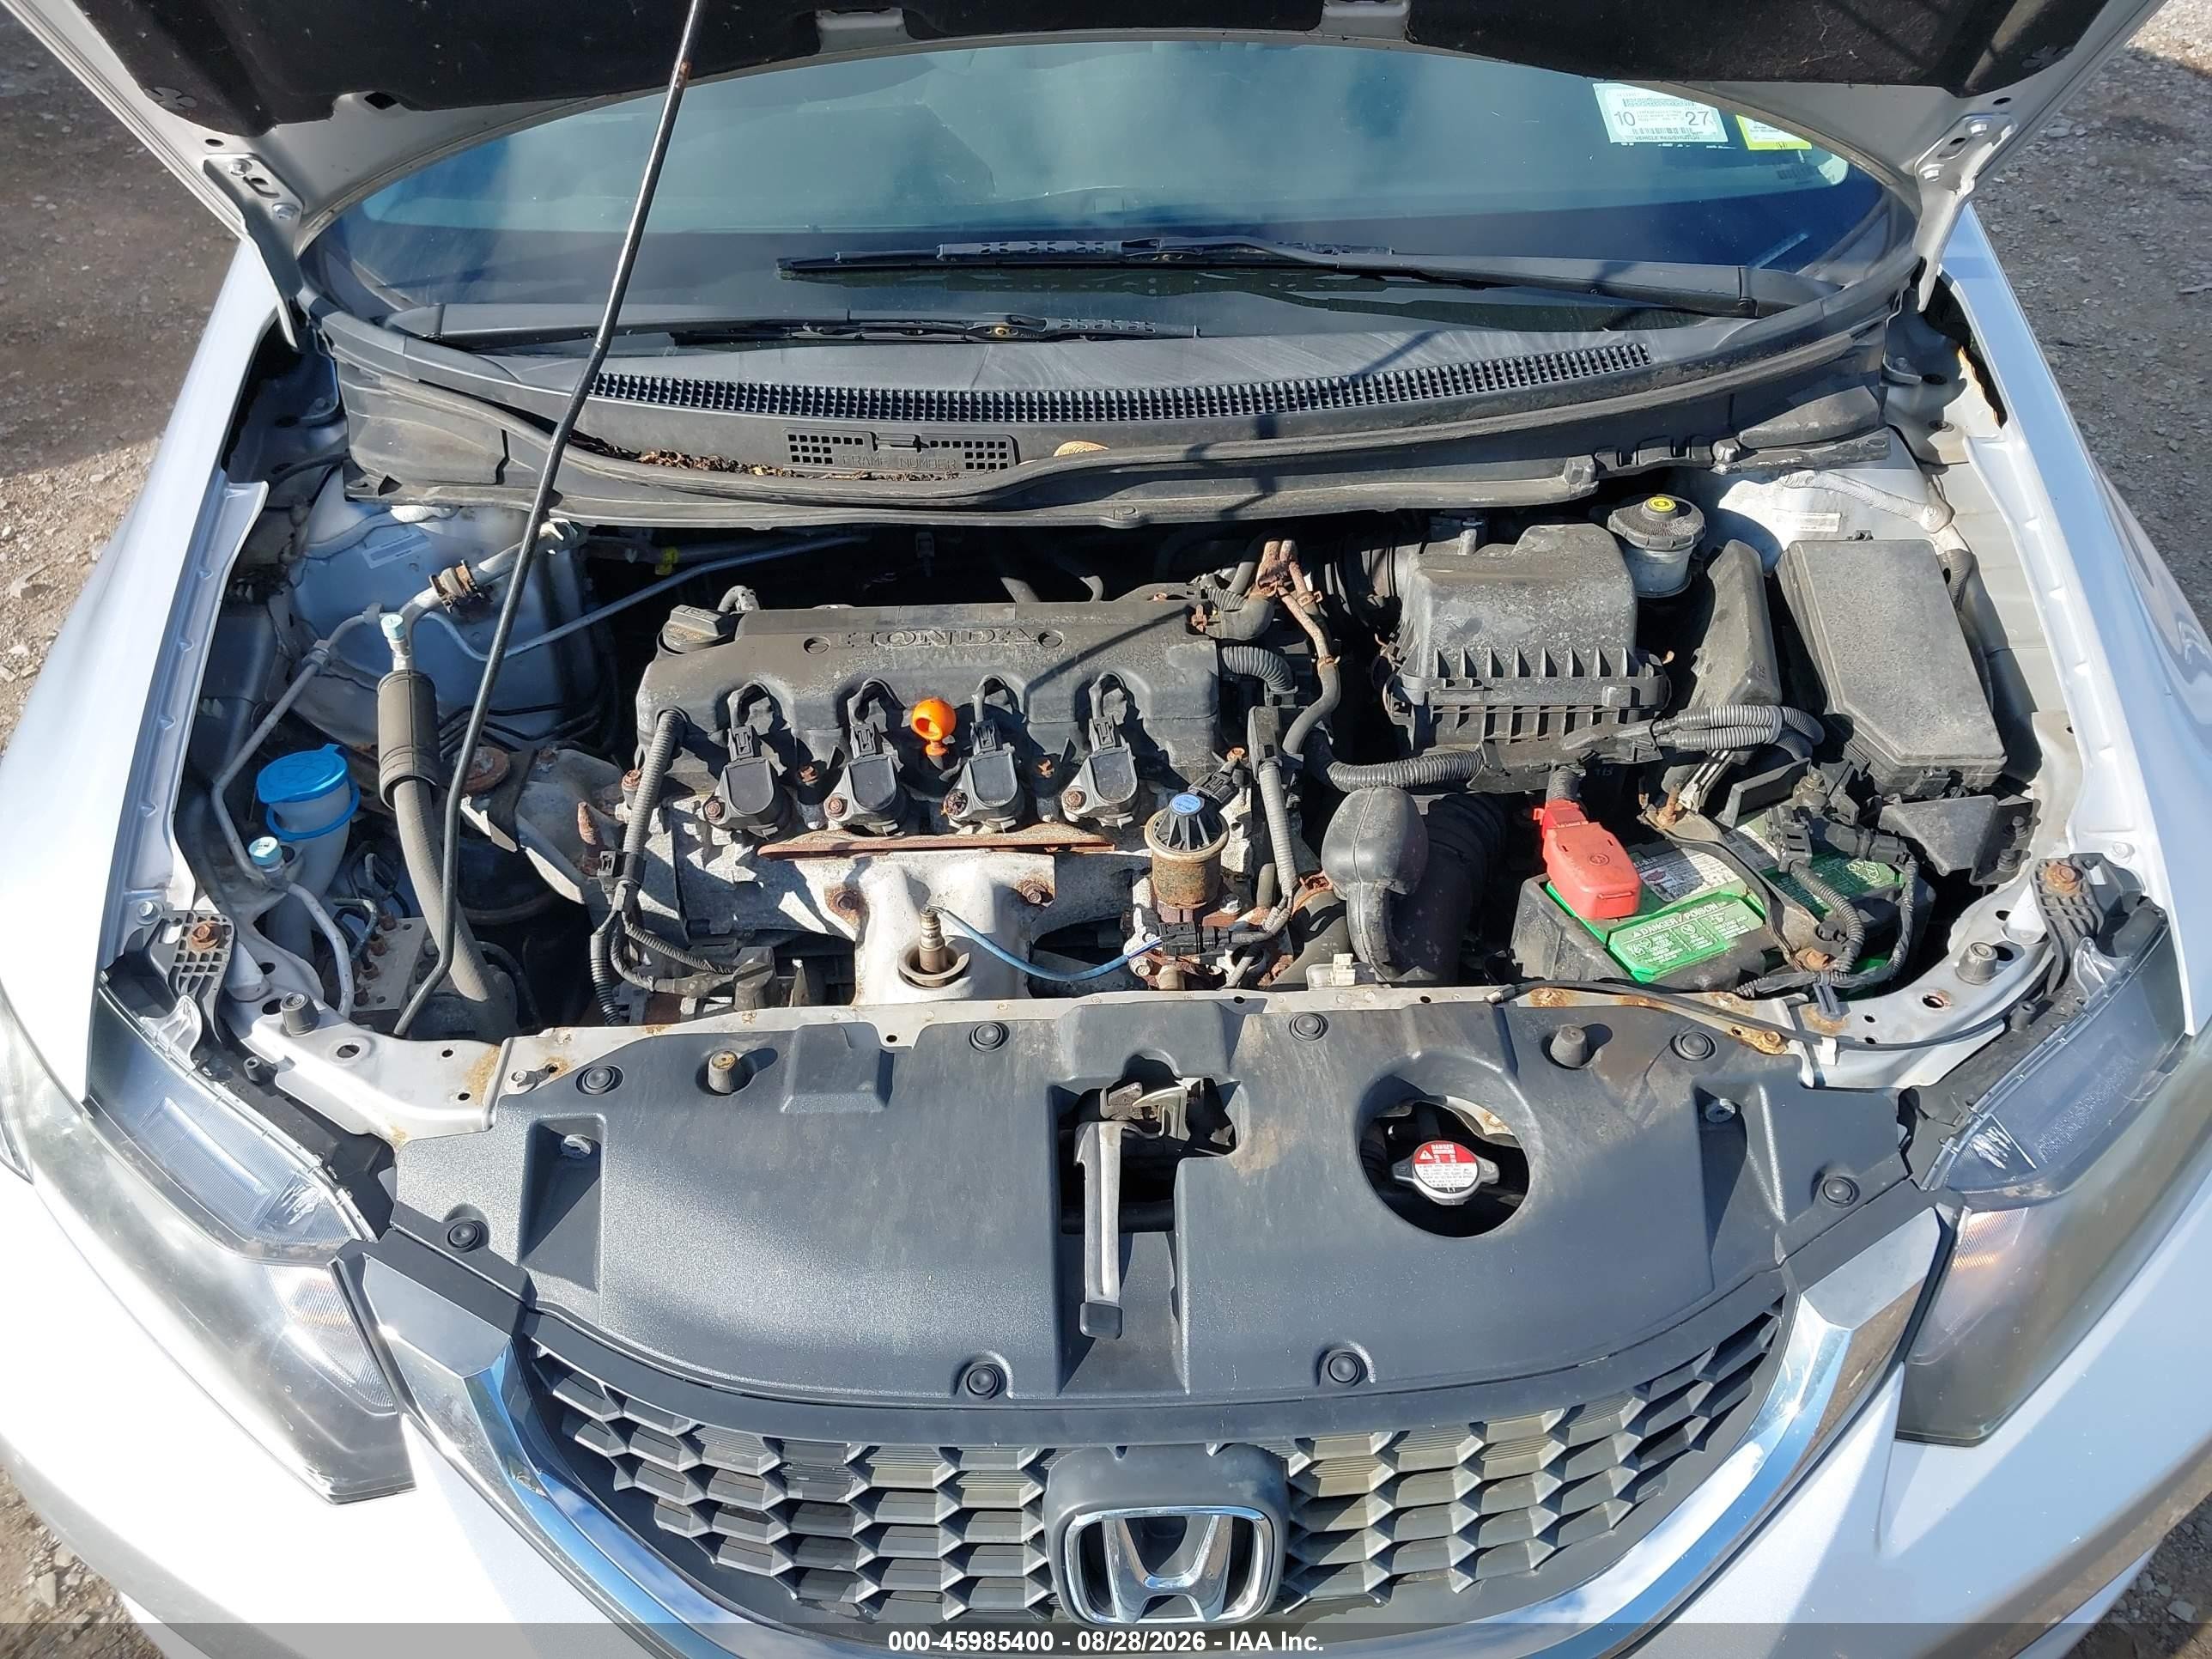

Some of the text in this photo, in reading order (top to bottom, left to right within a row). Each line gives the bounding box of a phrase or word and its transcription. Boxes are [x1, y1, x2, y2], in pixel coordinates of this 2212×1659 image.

[1614, 111, 1636, 126] 10
[1685, 111, 1710, 126] 27
[842, 454, 957, 470] FRAME NUMBER
